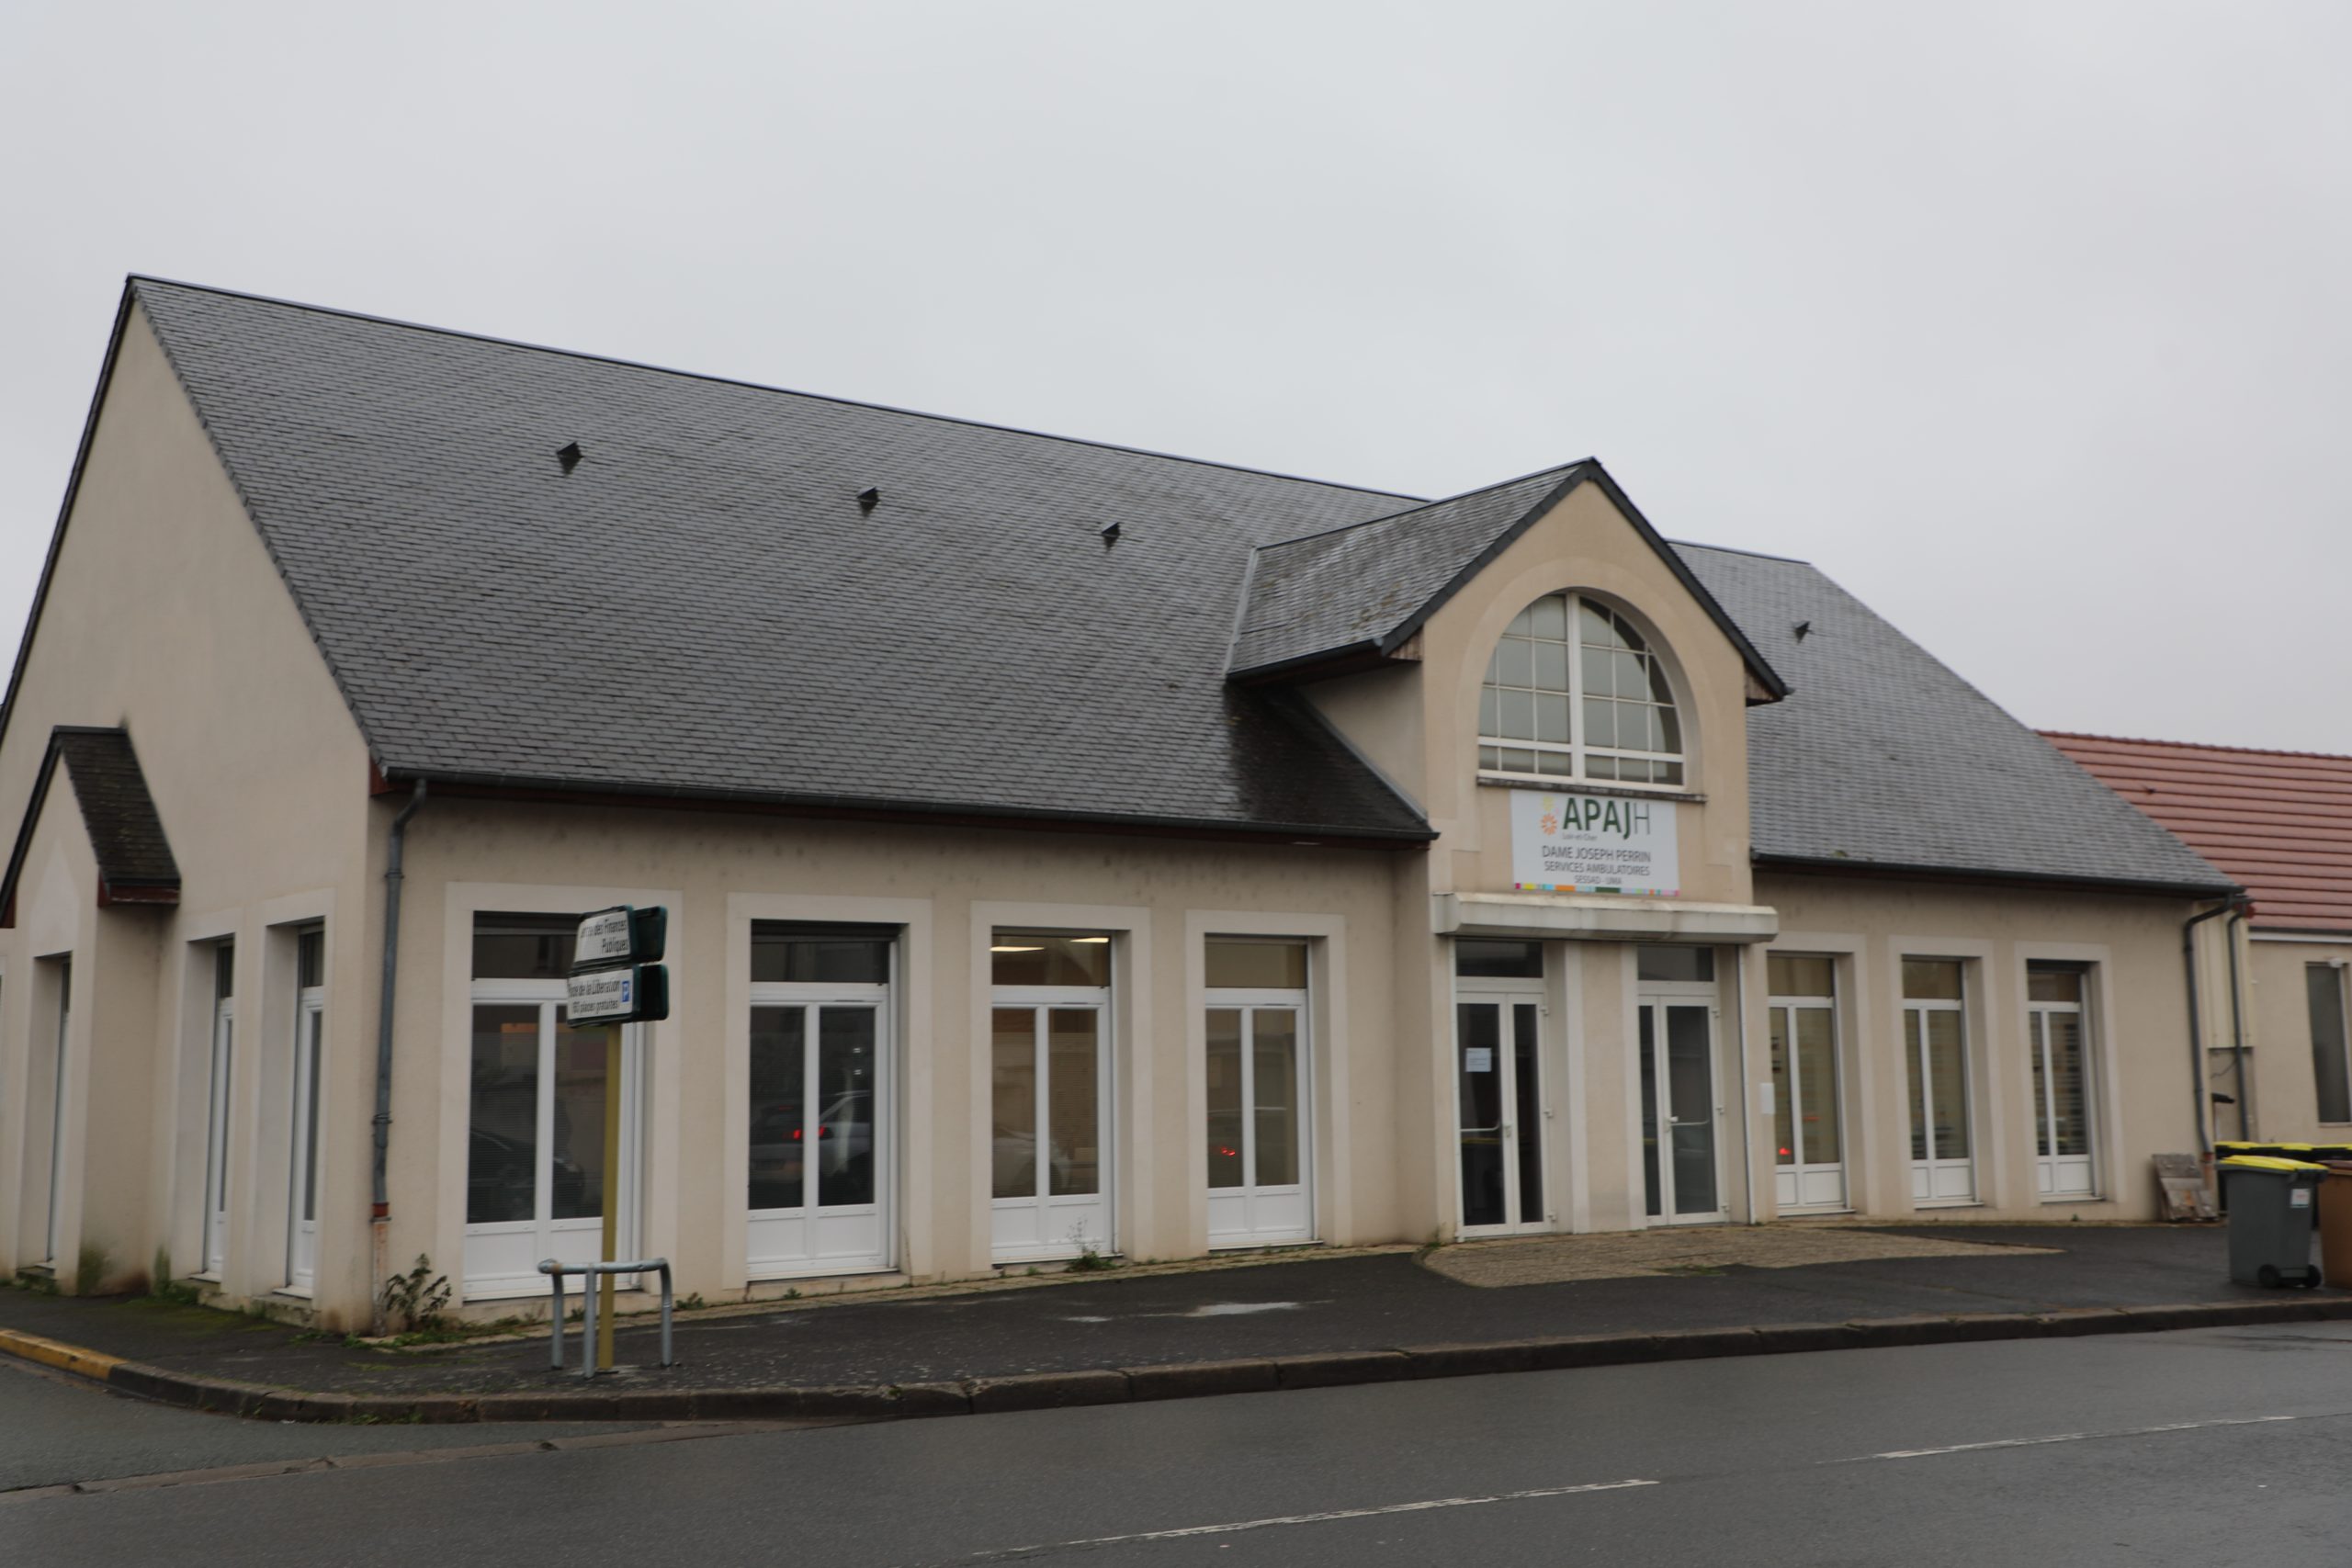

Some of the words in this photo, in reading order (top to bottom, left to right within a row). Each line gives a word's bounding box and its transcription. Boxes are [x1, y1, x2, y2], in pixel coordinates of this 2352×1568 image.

[1563, 797, 1650, 840] APAJH
[1542, 845, 1573, 859] DAME
[1575, 847, 1613, 861] JOSEPH
[1616, 850, 1651, 863] PERRIN
[1544, 861, 1584, 873] SERVICES
[1586, 863, 1650, 876] AMBULATOIRES
[605, 919, 627, 934] Finances
[602, 937, 628, 953] Publiques
